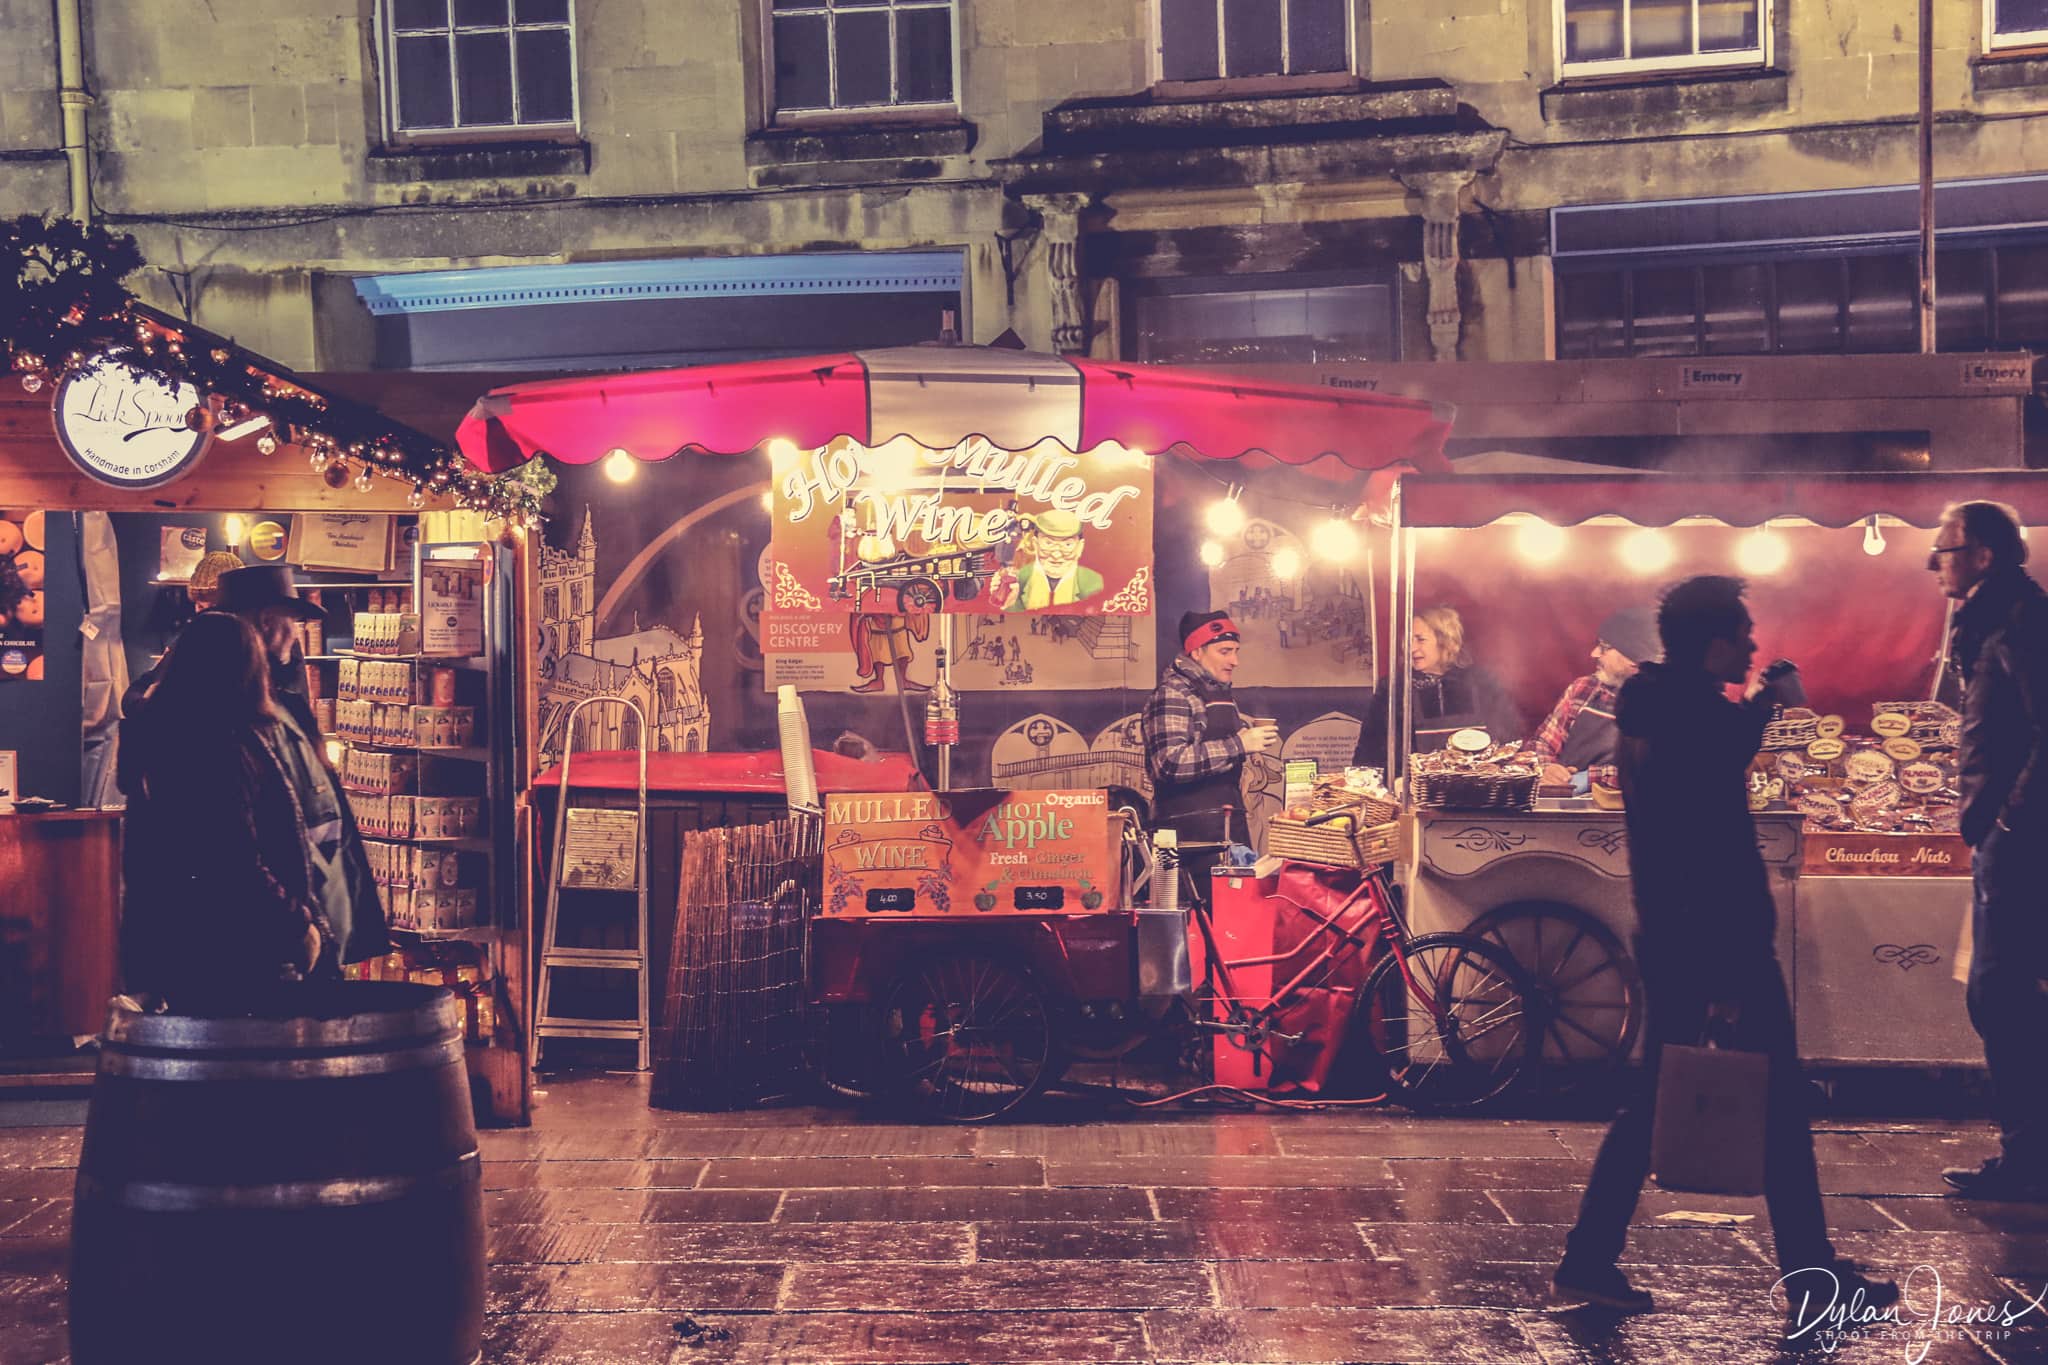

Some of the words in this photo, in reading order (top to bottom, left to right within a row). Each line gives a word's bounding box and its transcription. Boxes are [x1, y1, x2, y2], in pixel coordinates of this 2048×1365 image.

[1693, 370, 1743, 385] Emery
[1974, 366, 2026, 379] Emery
[84, 447, 131, 475] Handmade
[144, 450, 180, 474] Corsham
[782, 438, 862, 522] Ho
[923, 434, 1141, 529] Mulled
[854, 489, 1009, 545] Wine
[769, 623, 843, 635] DISCOVERY
[769, 636, 819, 648] CENTRE
[1046, 793, 1104, 808] Organic
[827, 797, 952, 825] MULLED
[998, 803, 1044, 819] HOT
[976, 812, 1073, 848] Apple
[855, 842, 928, 869] WINE
[990, 851, 1028, 865] Fresh
[1035, 851, 1085, 866] Ginger
[1825, 847, 1899, 863] Chouchou
[1911, 846, 1952, 863] Nuts
[1000, 866, 1014, 882] &
